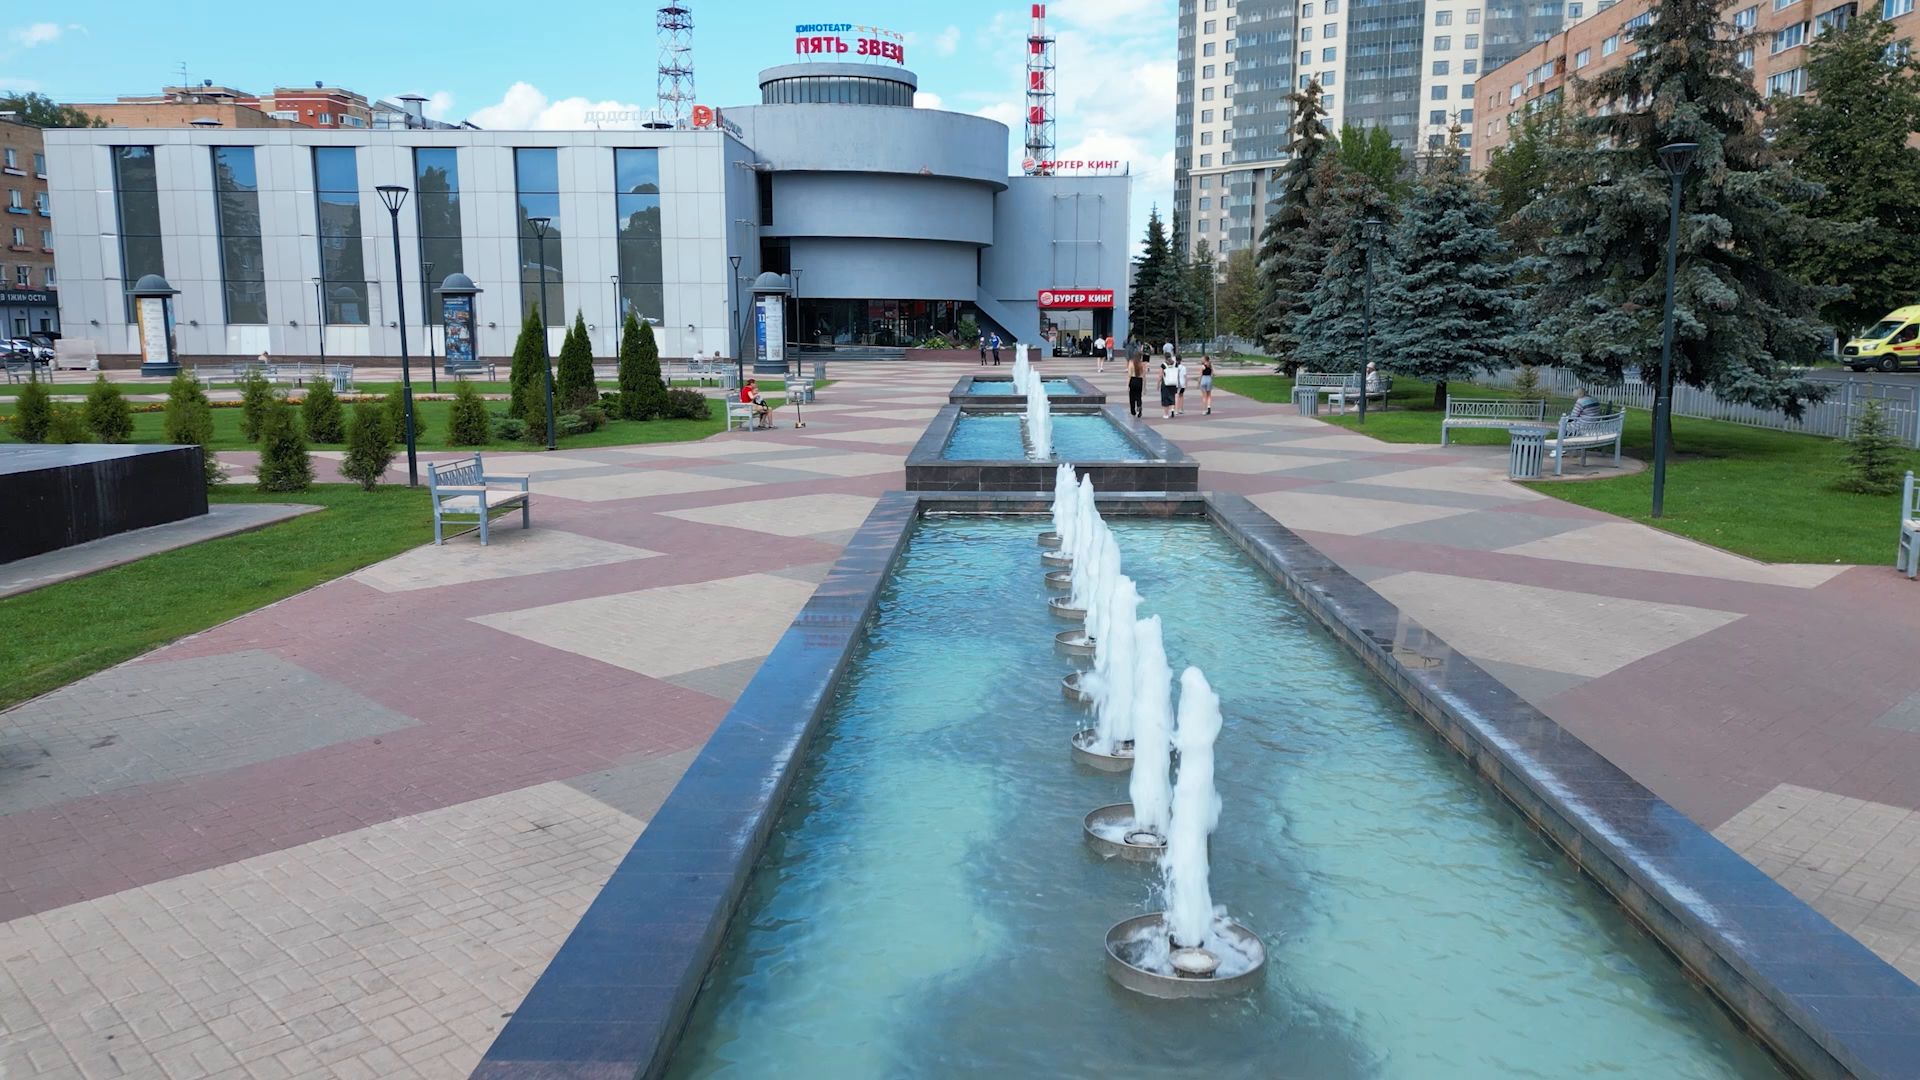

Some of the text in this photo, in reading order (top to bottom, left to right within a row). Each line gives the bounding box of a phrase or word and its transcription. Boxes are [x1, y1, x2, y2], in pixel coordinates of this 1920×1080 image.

[796, 24, 852, 33] КИНОТЕАТР
[796, 36, 904, 65] ПЯТЬ ЗВЕЗД
[1041, 160, 1084, 169] БУРГЕР
[1088, 160, 1120, 169] КИНГ
[1053, 294, 1085, 303] БУРГЕР
[1088, 294, 1113, 303] КИНГ
